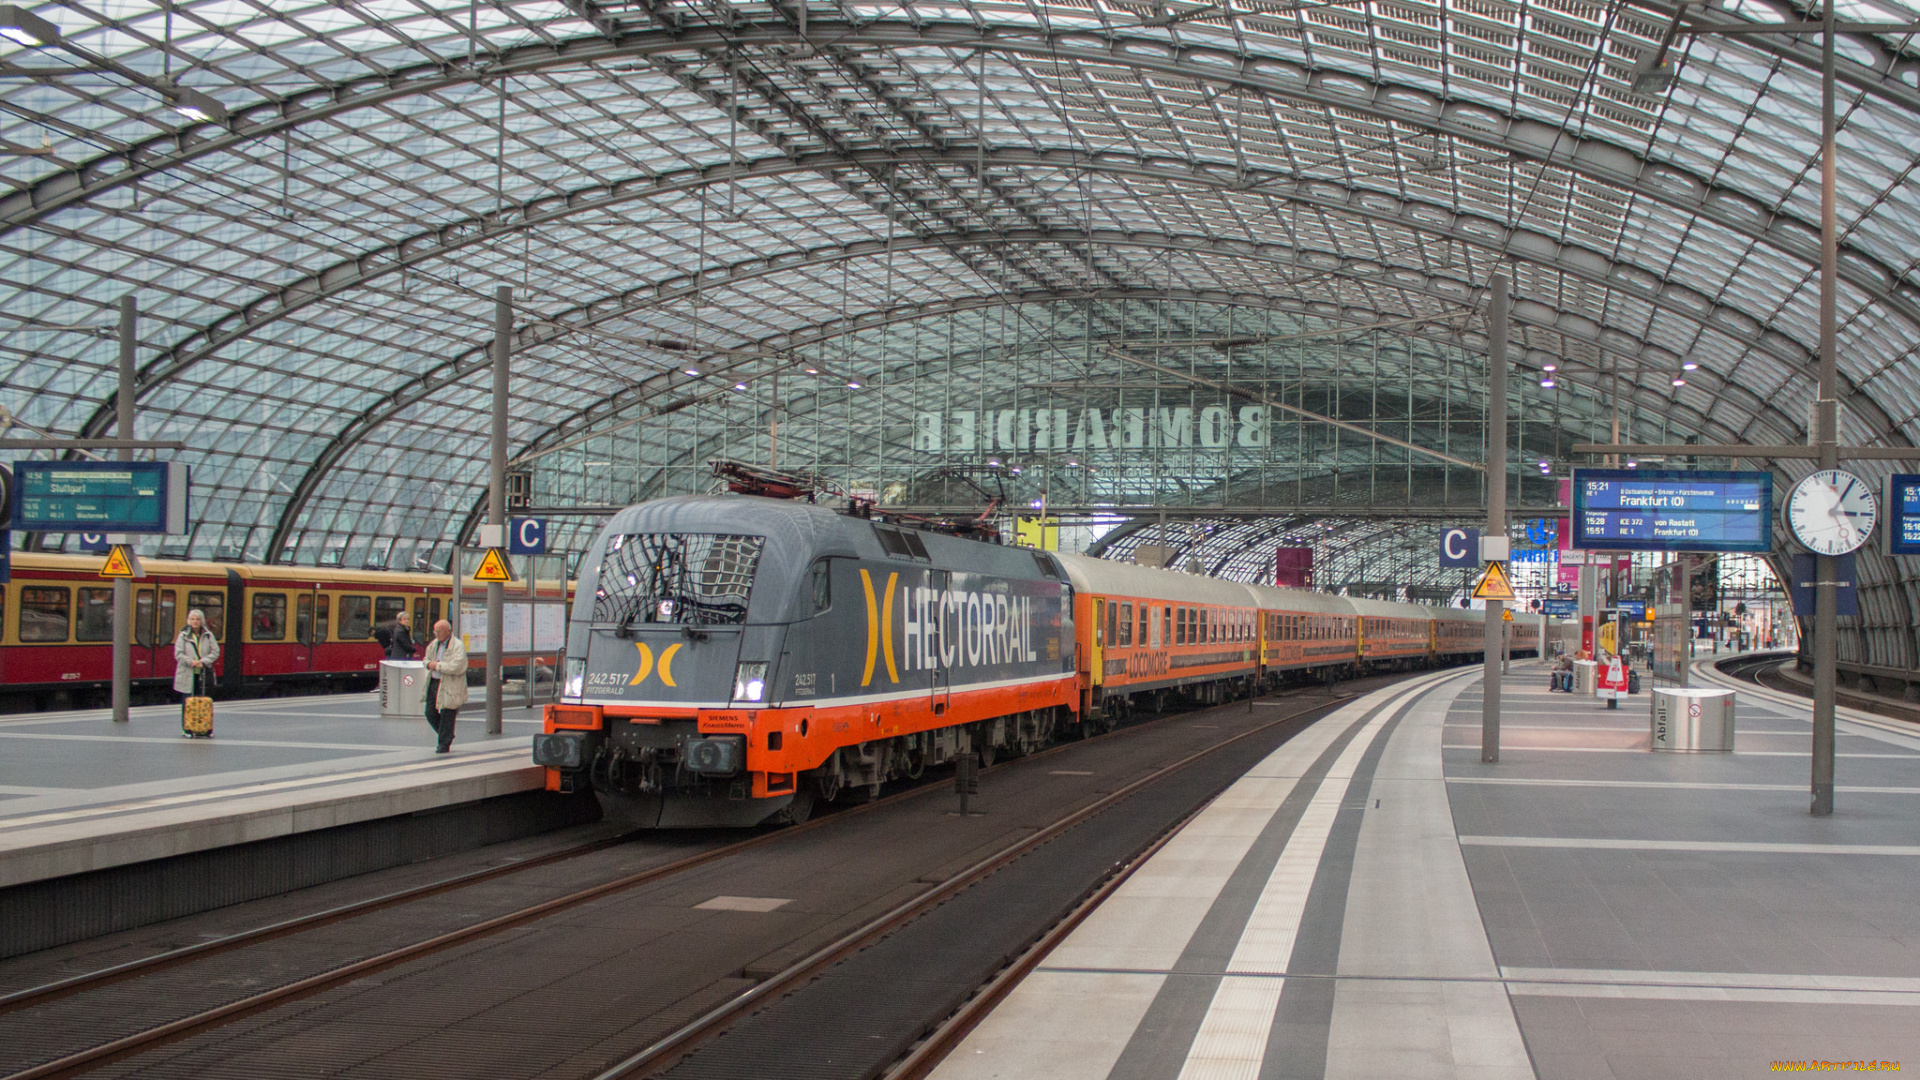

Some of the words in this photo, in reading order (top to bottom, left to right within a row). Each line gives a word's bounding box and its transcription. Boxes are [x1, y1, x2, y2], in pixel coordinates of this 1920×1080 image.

[1587, 482, 1609, 490] 15:21
[1620, 496, 1668, 506] Frankfurt
[520, 519, 540, 548] C
[1444, 529, 1467, 560] C
[1558, 583, 1568, 592] 12
[904, 586, 1036, 670] HECTORRAIL
[1129, 652, 1168, 678] LOCOMORE
[588, 673, 630, 686] 242.517
[586, 686, 624, 695] FITZGERALD
[1657, 708, 1667, 742] Abfall
